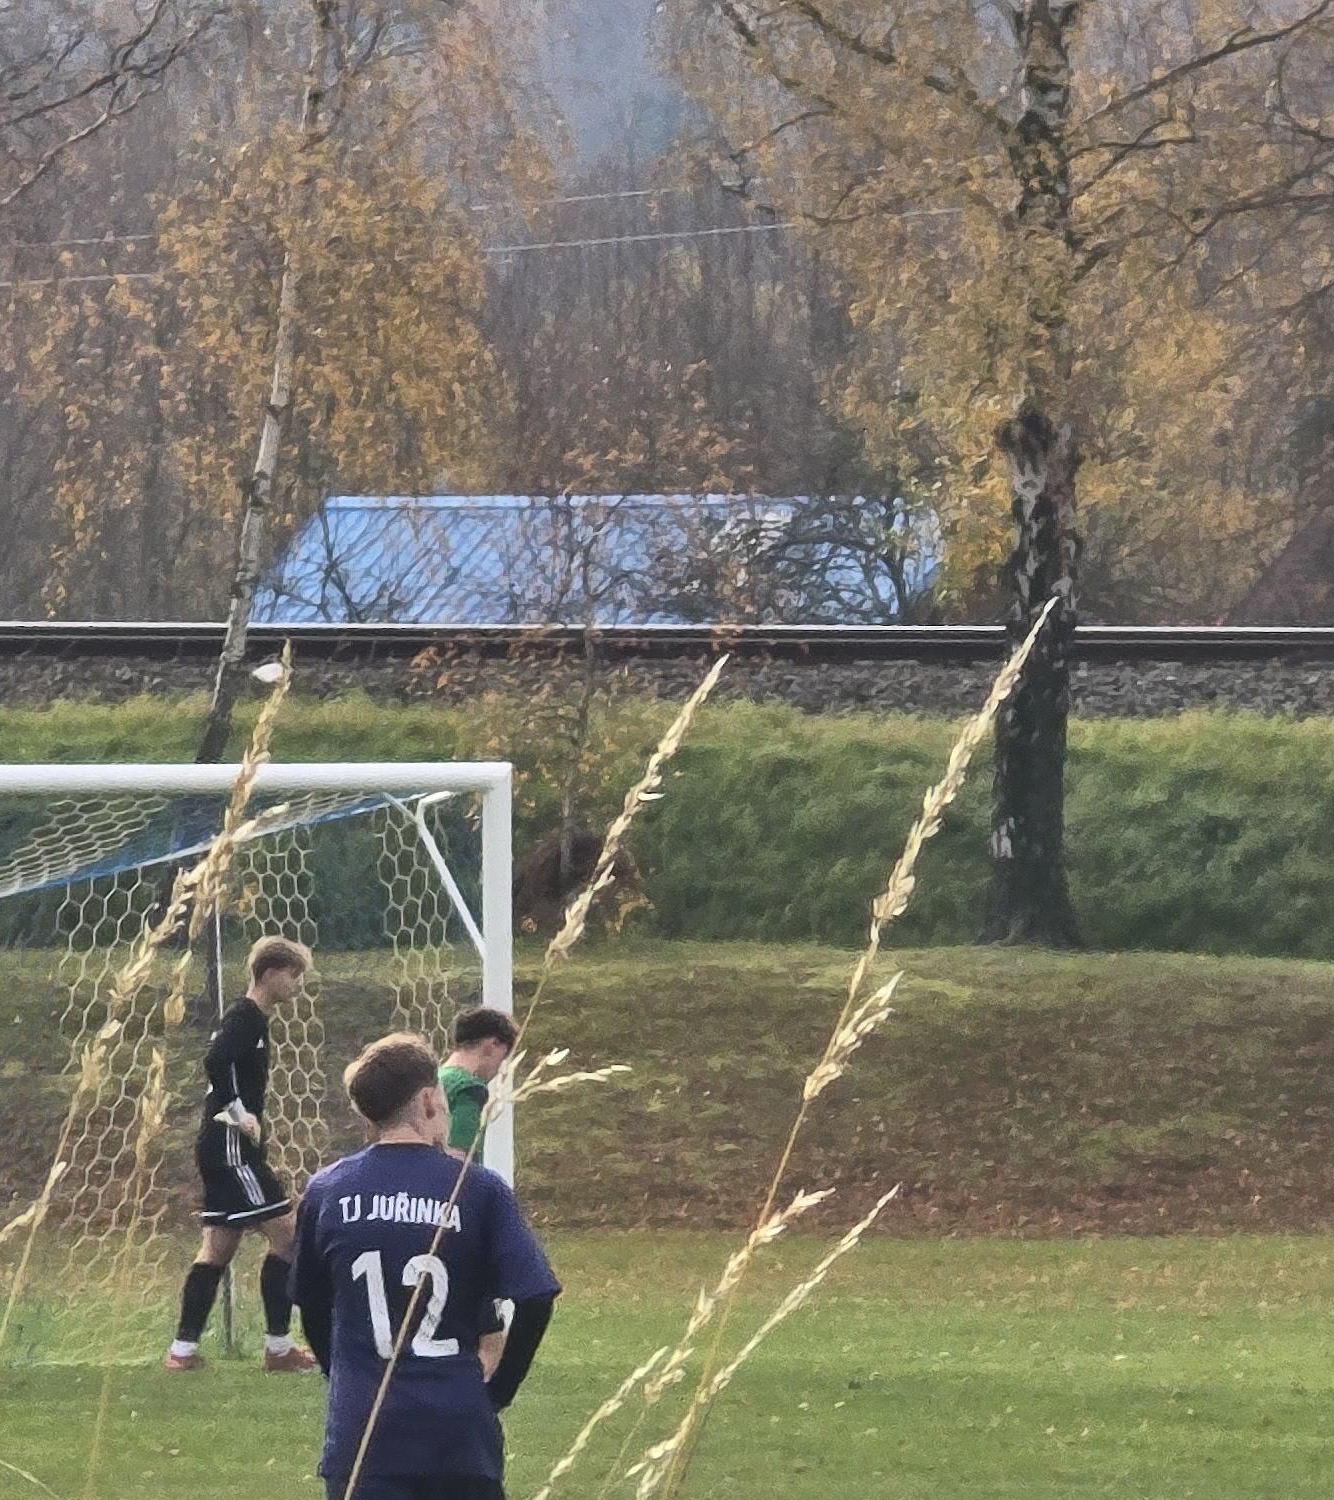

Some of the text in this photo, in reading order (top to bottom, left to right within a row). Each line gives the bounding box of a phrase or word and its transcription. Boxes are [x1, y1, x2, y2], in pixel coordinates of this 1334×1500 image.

[339, 1191, 462, 1233] TJ JUŘINKA
[351, 1250, 460, 1359] 12
